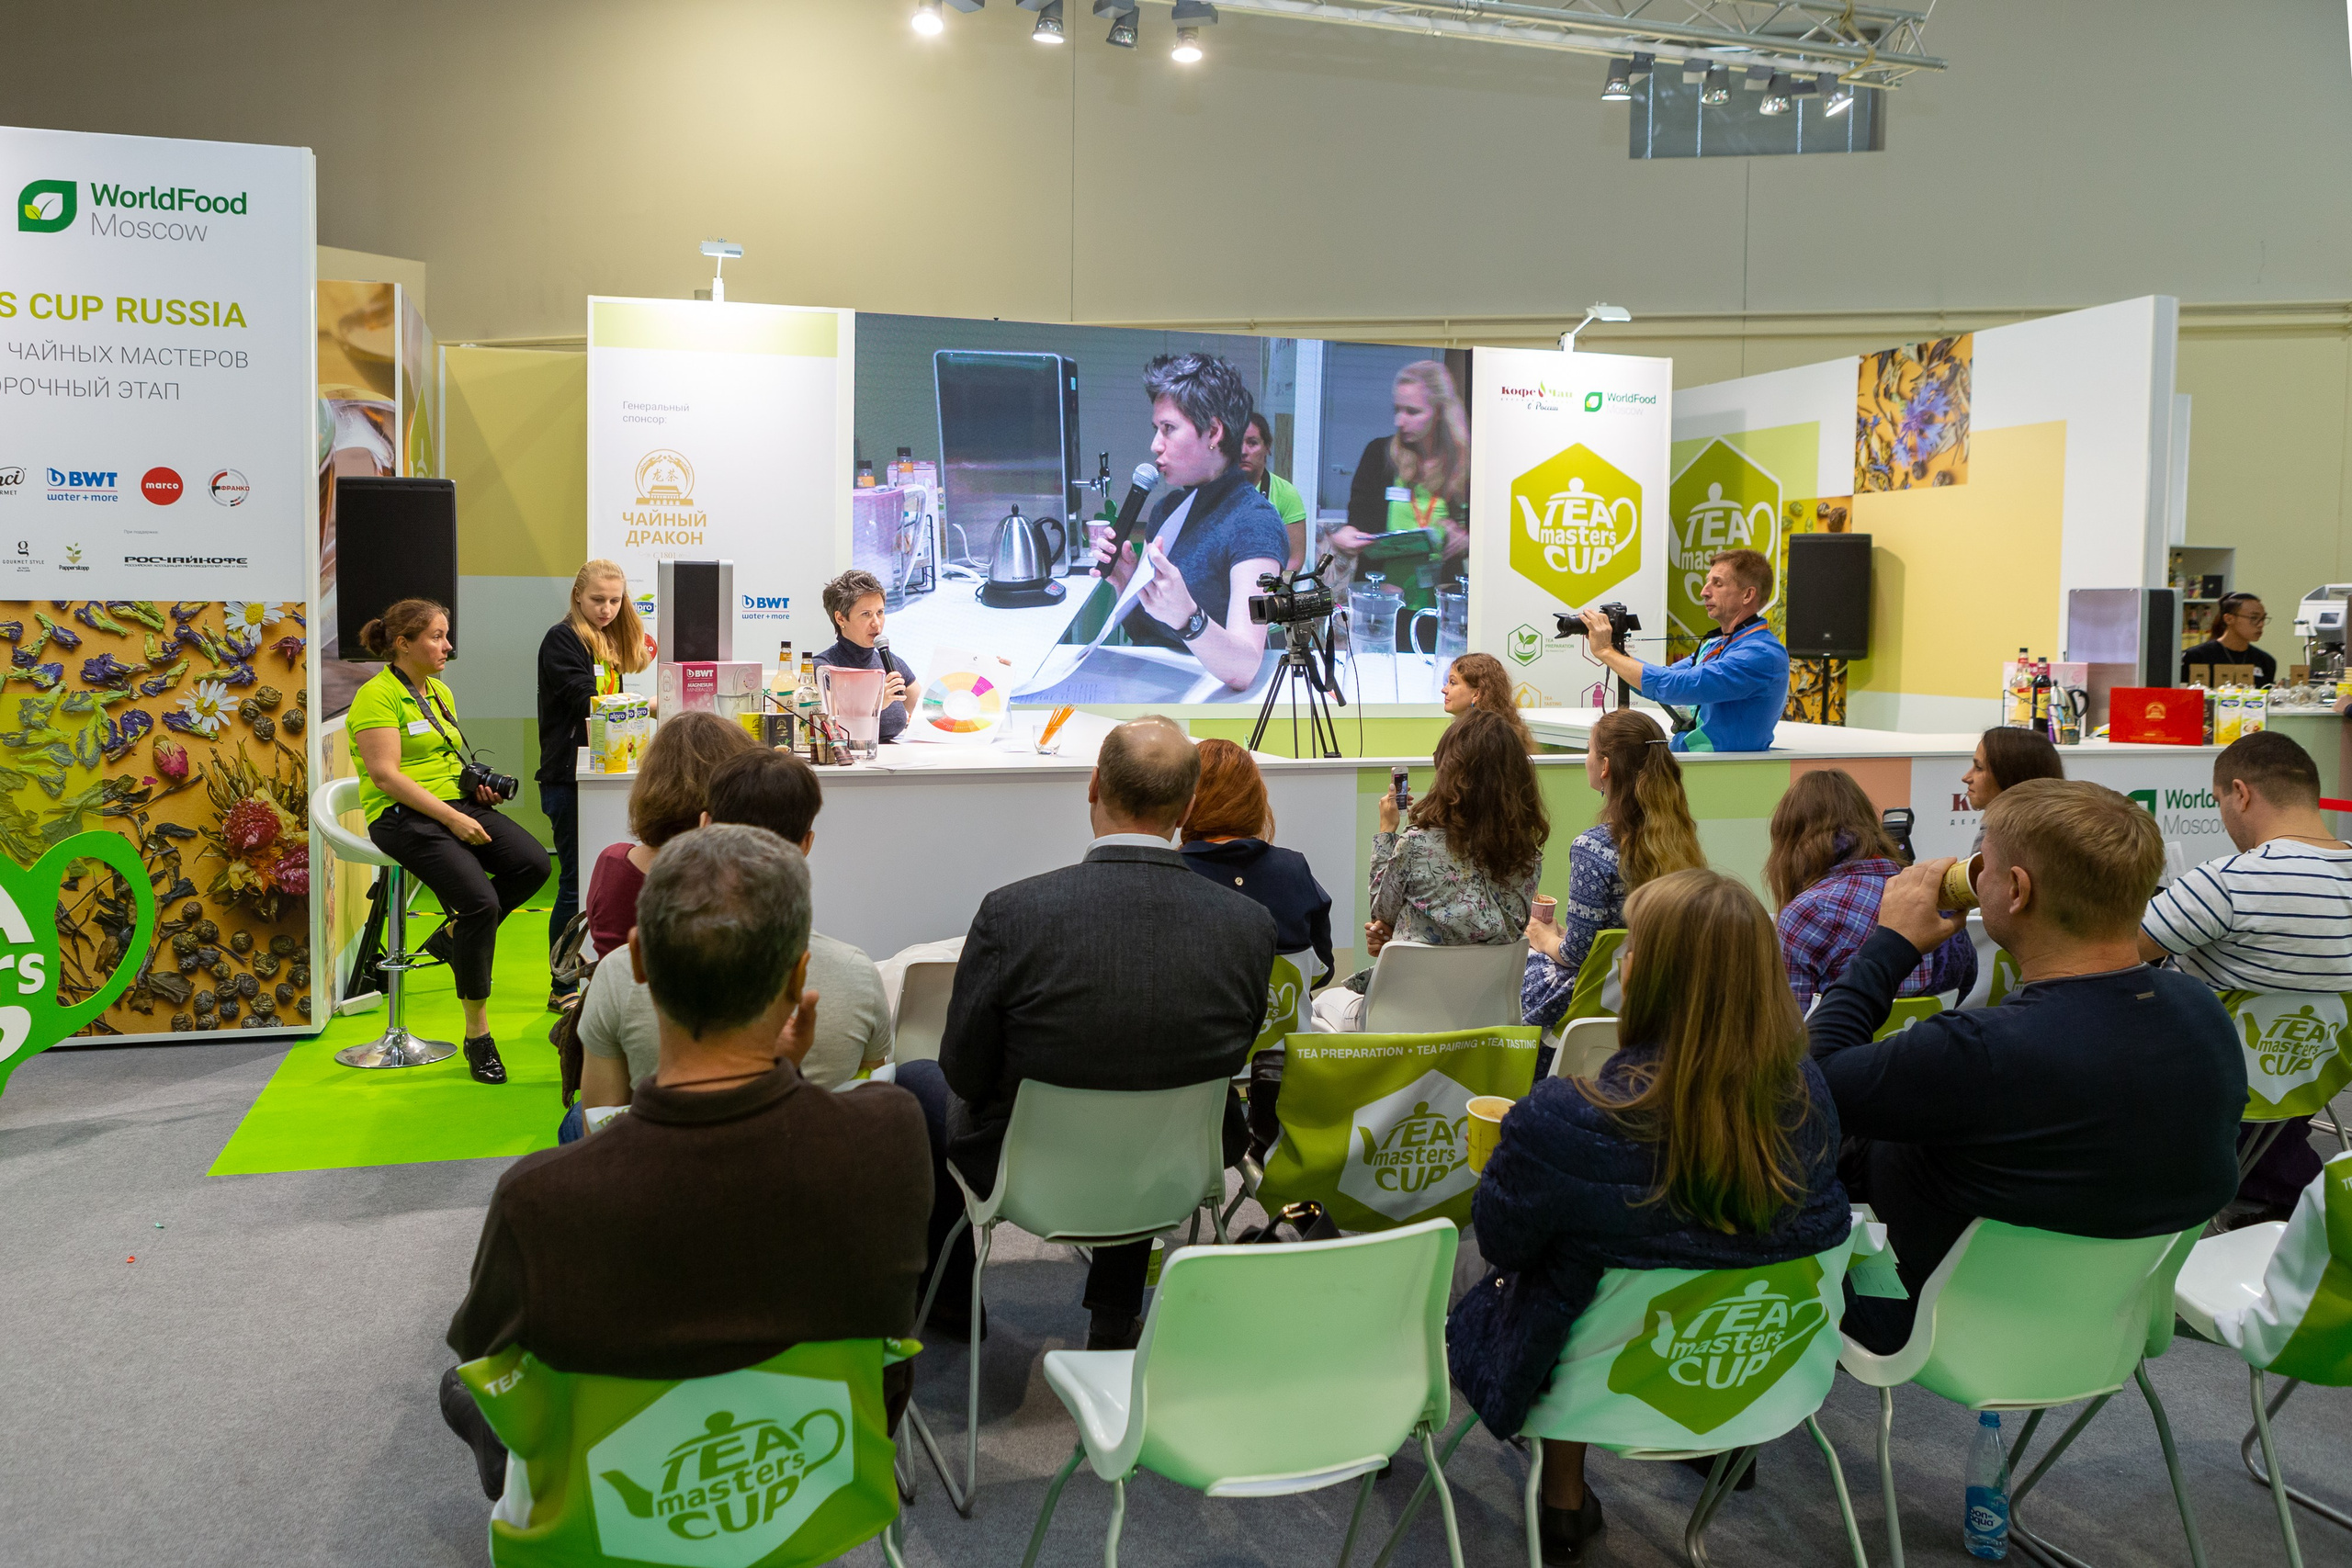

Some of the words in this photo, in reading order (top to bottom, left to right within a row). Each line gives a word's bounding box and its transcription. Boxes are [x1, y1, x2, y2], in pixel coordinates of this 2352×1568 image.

[90, 182, 247, 215] WorldFood
[91, 212, 209, 242] Moscow
[29, 292, 104, 321] CUP
[116, 296, 248, 328] RUSSIA
[8, 339, 113, 364] ЧАЙНЫХ
[121, 345, 249, 368] МАСТЕРОВ
[0, 376, 109, 398] РОЧНЫЙ
[119, 380, 180, 400] ЭТАП
[1607, 392, 1657, 404] WorldFood
[622, 400, 690, 412] Генеральный
[622, 413, 667, 425] спонсор:
[69, 471, 118, 487] BWT
[47, 492, 81, 501] water
[622, 509, 707, 527] ЧАЙНЫЙ
[1543, 499, 1614, 529] TEA
[625, 530, 703, 547] ДРАКОН
[1540, 526, 1617, 546] masters
[1684, 510, 1752, 548] TEA
[124, 555, 248, 564] РОСЧАЙКОФЕ
[1544, 545, 1613, 575] CUP
[634, 603, 652, 613] lpro
[756, 597, 790, 609] BWT
[695, 670, 714, 678] BWT
[609, 712, 626, 722] alpro
[2165, 787, 2221, 809] World
[2264, 1019, 2326, 1043] TEA
[1296, 1048, 1318, 1058] TEA
[1320, 1046, 1404, 1059] PREPARATION
[1417, 1044, 1437, 1055] TEA
[1439, 1039, 1478, 1054] PAIRING
[1487, 1037, 1504, 1048] TEA
[1505, 1038, 1537, 1050] TASTING
[2257, 1039, 2321, 1057] masters
[2258, 1054, 2313, 1076] CUP
[1380, 1120, 1455, 1150] TEA
[1373, 1145, 1456, 1167] masters
[1374, 1165, 1450, 1193] CUP
[1681, 1301, 1789, 1339] TEA
[1671, 1328, 1785, 1359] masters
[1668, 1352, 1773, 1390] CUP
[661, 1425, 799, 1495] TEA
[657, 1450, 806, 1517] masters
[667, 1475, 801, 1540] CUP
